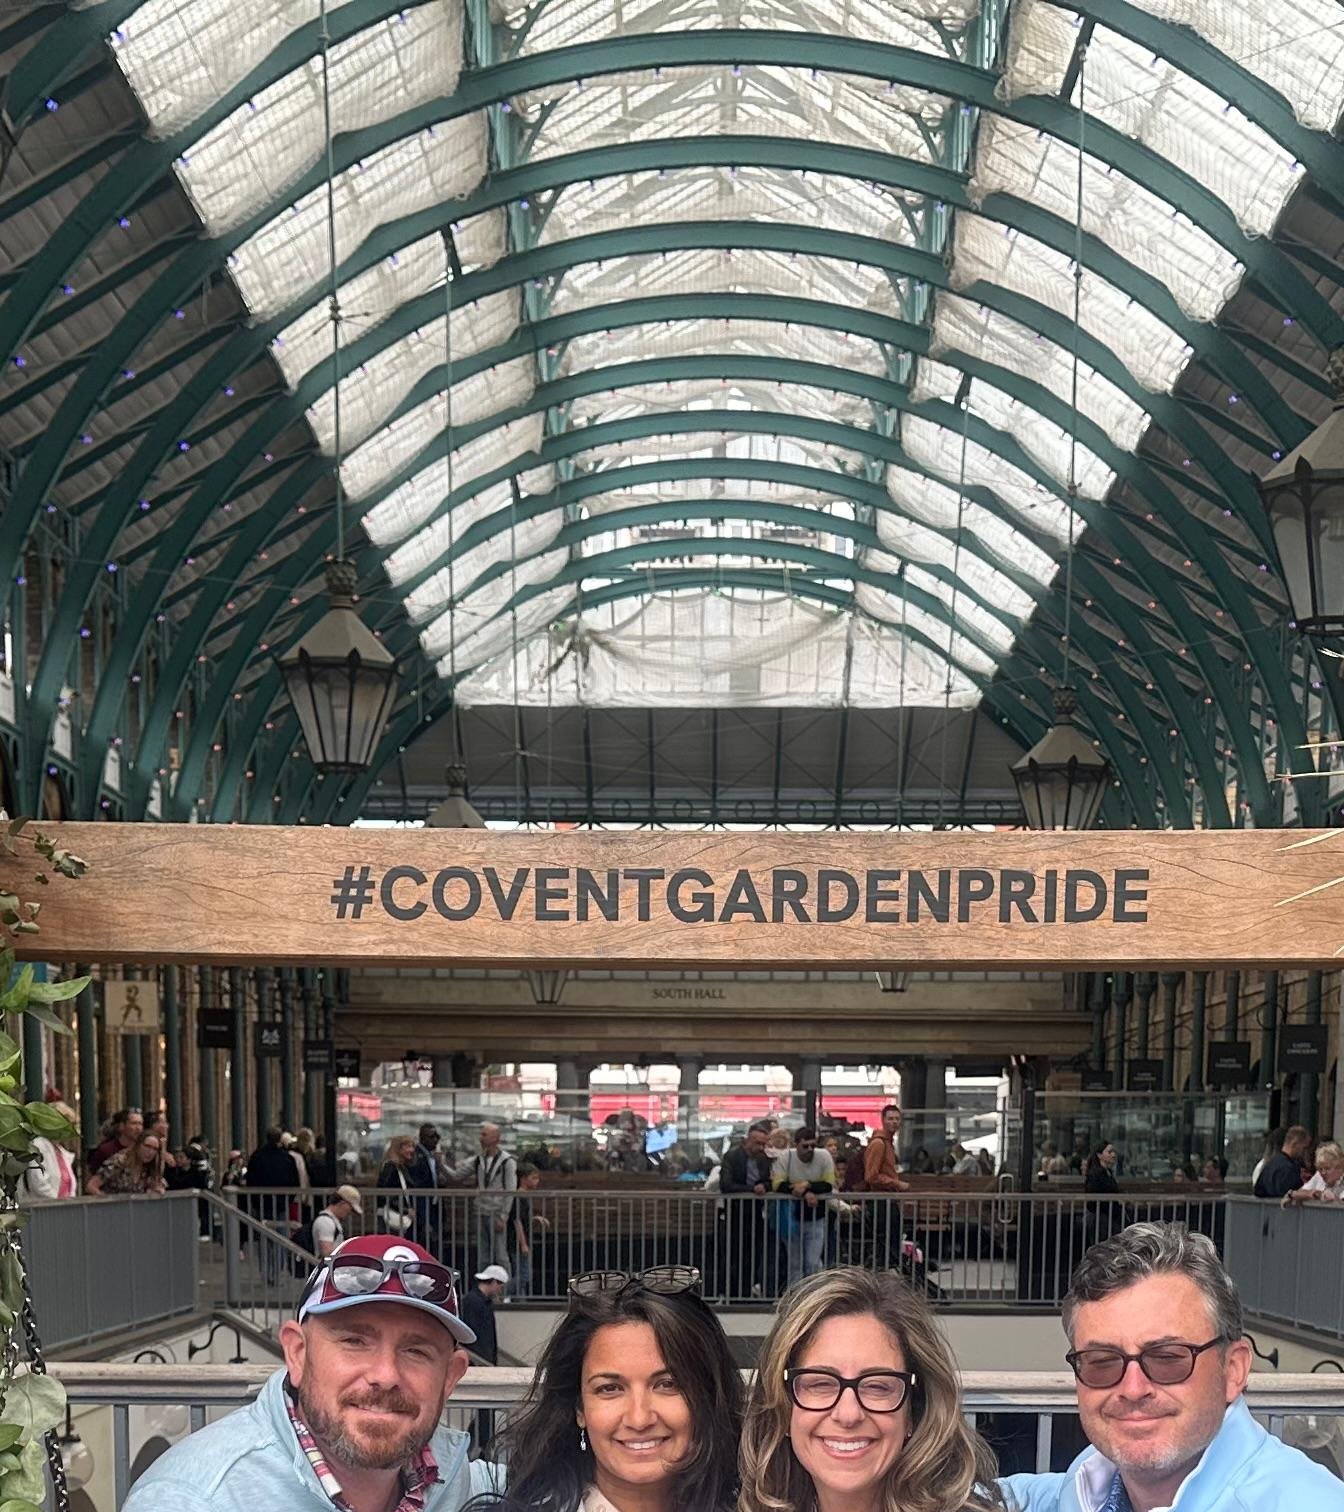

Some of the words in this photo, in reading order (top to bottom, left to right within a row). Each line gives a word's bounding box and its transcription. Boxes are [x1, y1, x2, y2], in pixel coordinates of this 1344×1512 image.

[330, 864, 1150, 924] #COVENTGARDENPRIDE
[652, 988, 692, 1000] SOUTH
[695, 988, 727, 1000] HALL
